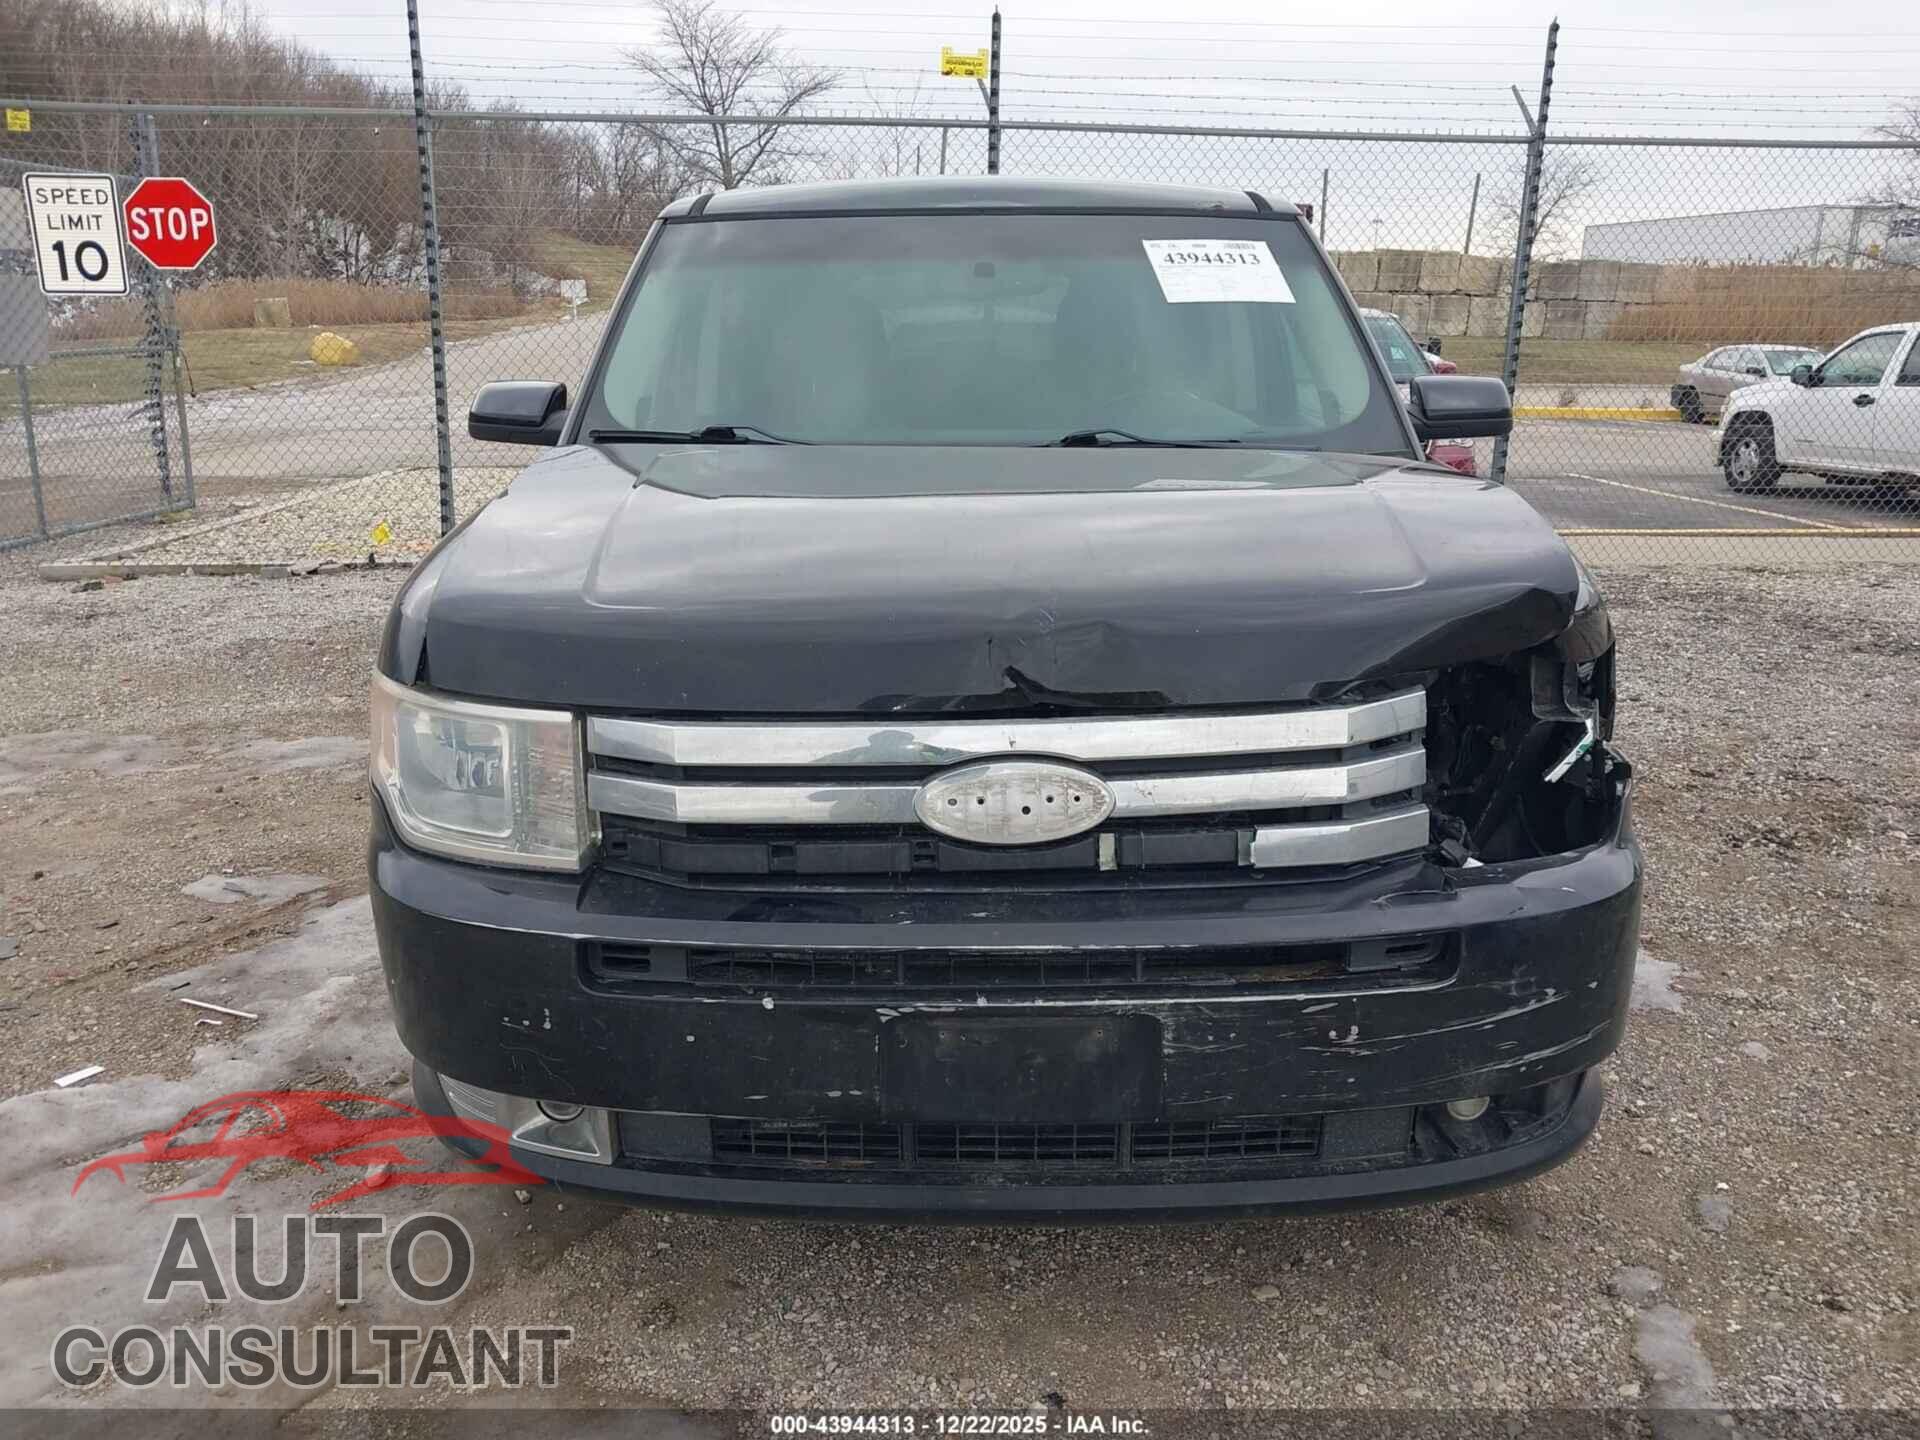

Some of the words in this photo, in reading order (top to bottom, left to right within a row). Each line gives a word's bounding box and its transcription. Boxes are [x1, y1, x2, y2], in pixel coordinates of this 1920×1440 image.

[35, 188, 109, 205] SPEED
[47, 213, 103, 231] LIMIT
[130, 207, 209, 241] STOP
[51, 240, 109, 282] 10
[1163, 252, 1261, 265] 43944313
